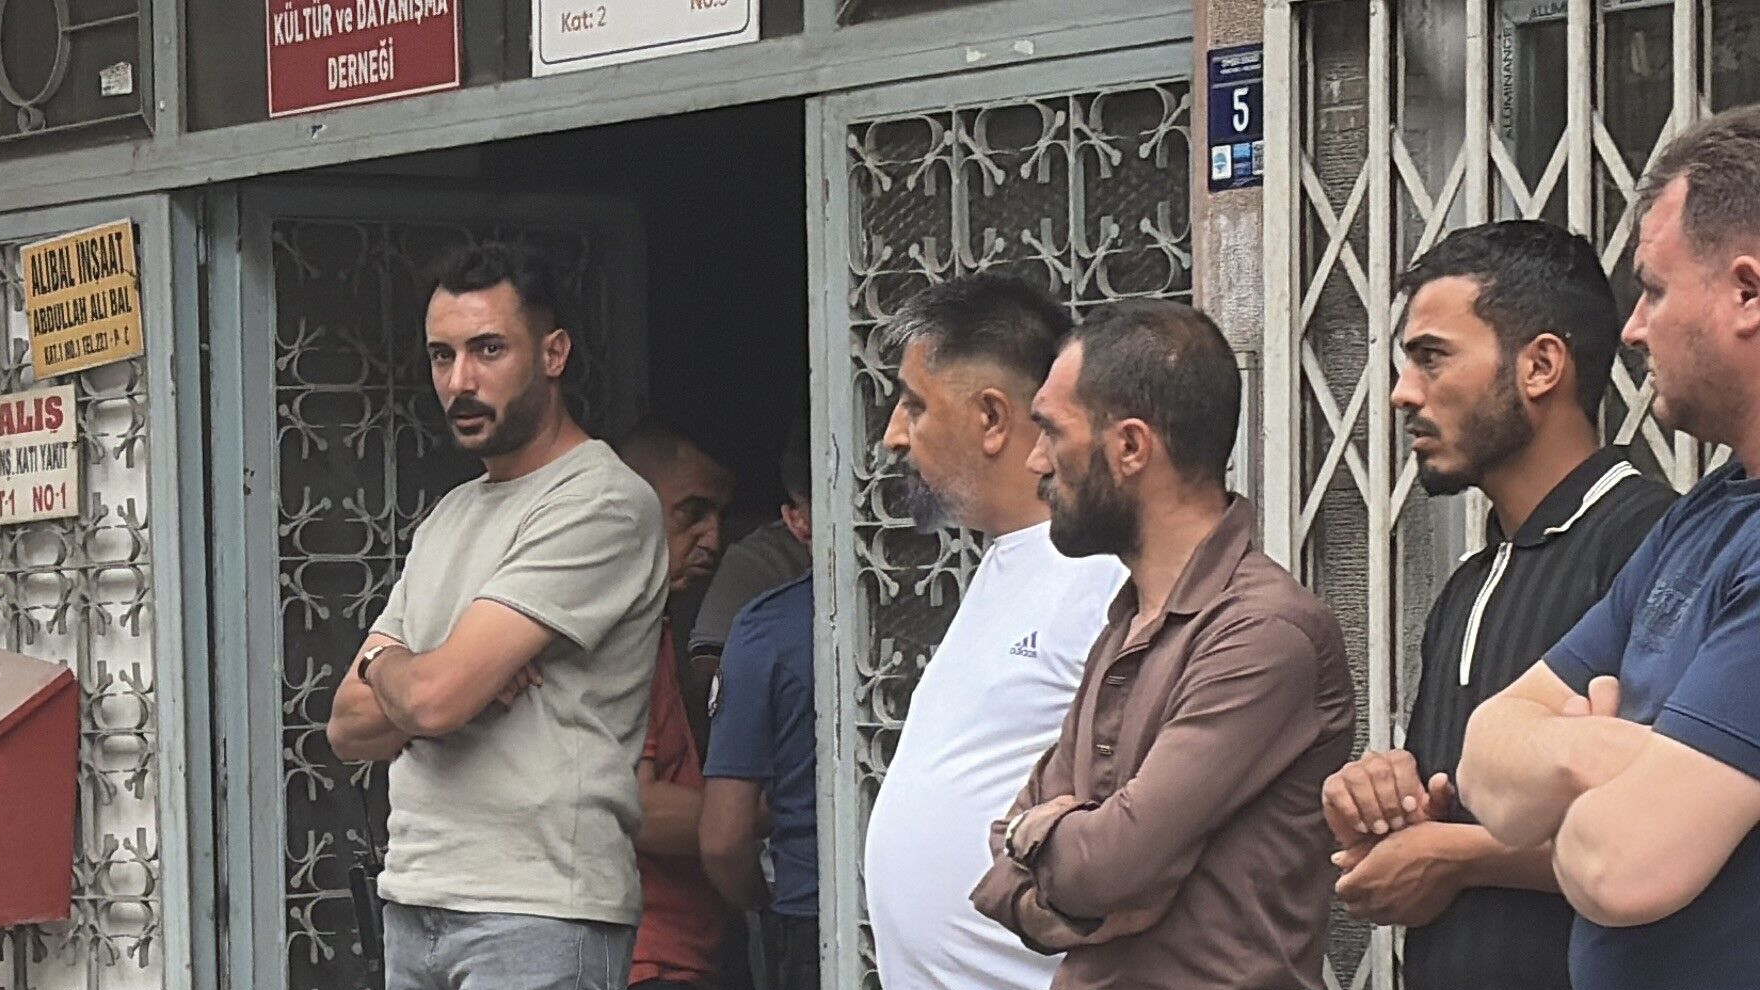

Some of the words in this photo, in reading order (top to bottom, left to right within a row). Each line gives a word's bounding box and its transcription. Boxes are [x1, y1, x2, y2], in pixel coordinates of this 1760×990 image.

[273, 0, 333, 46] KÜLTÜR
[335, 7, 353, 34] ve
[597, 6, 607, 27] 2
[328, 37, 394, 91] DERNEĞİ
[1233, 86, 1250, 132] 5
[33, 296, 88, 337] ABDULLAH
[109, 285, 132, 317] BAL
